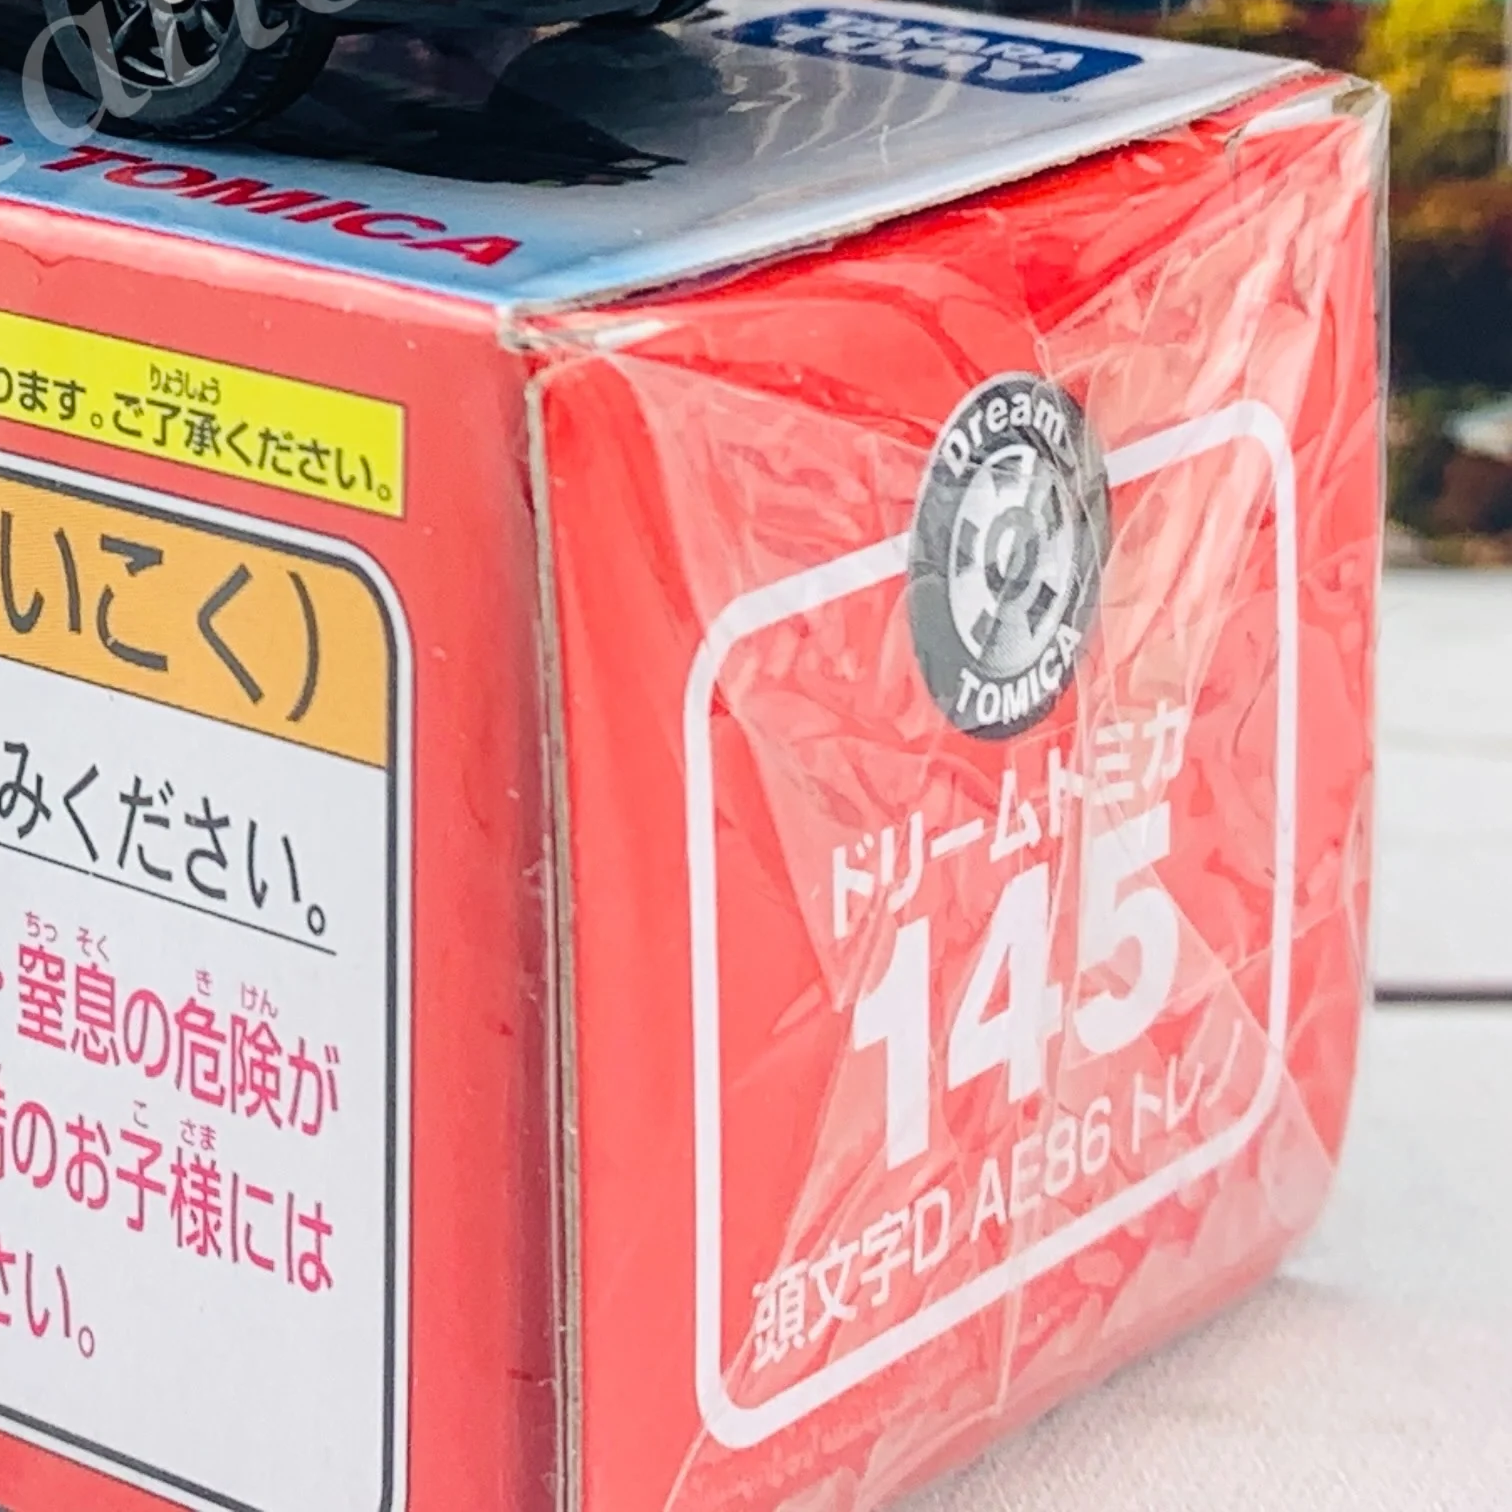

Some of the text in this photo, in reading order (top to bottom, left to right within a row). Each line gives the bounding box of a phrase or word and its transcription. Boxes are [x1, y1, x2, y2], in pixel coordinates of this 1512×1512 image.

[41, 144, 526, 268] TOMICA
[941, 391, 1068, 478] Dream
[954, 623, 1083, 726] TOMICA
[832, 699, 1190, 939] ドリームトミカ
[852, 799, 1181, 1171] 145
[971, 1094, 1113, 1242] AE86
